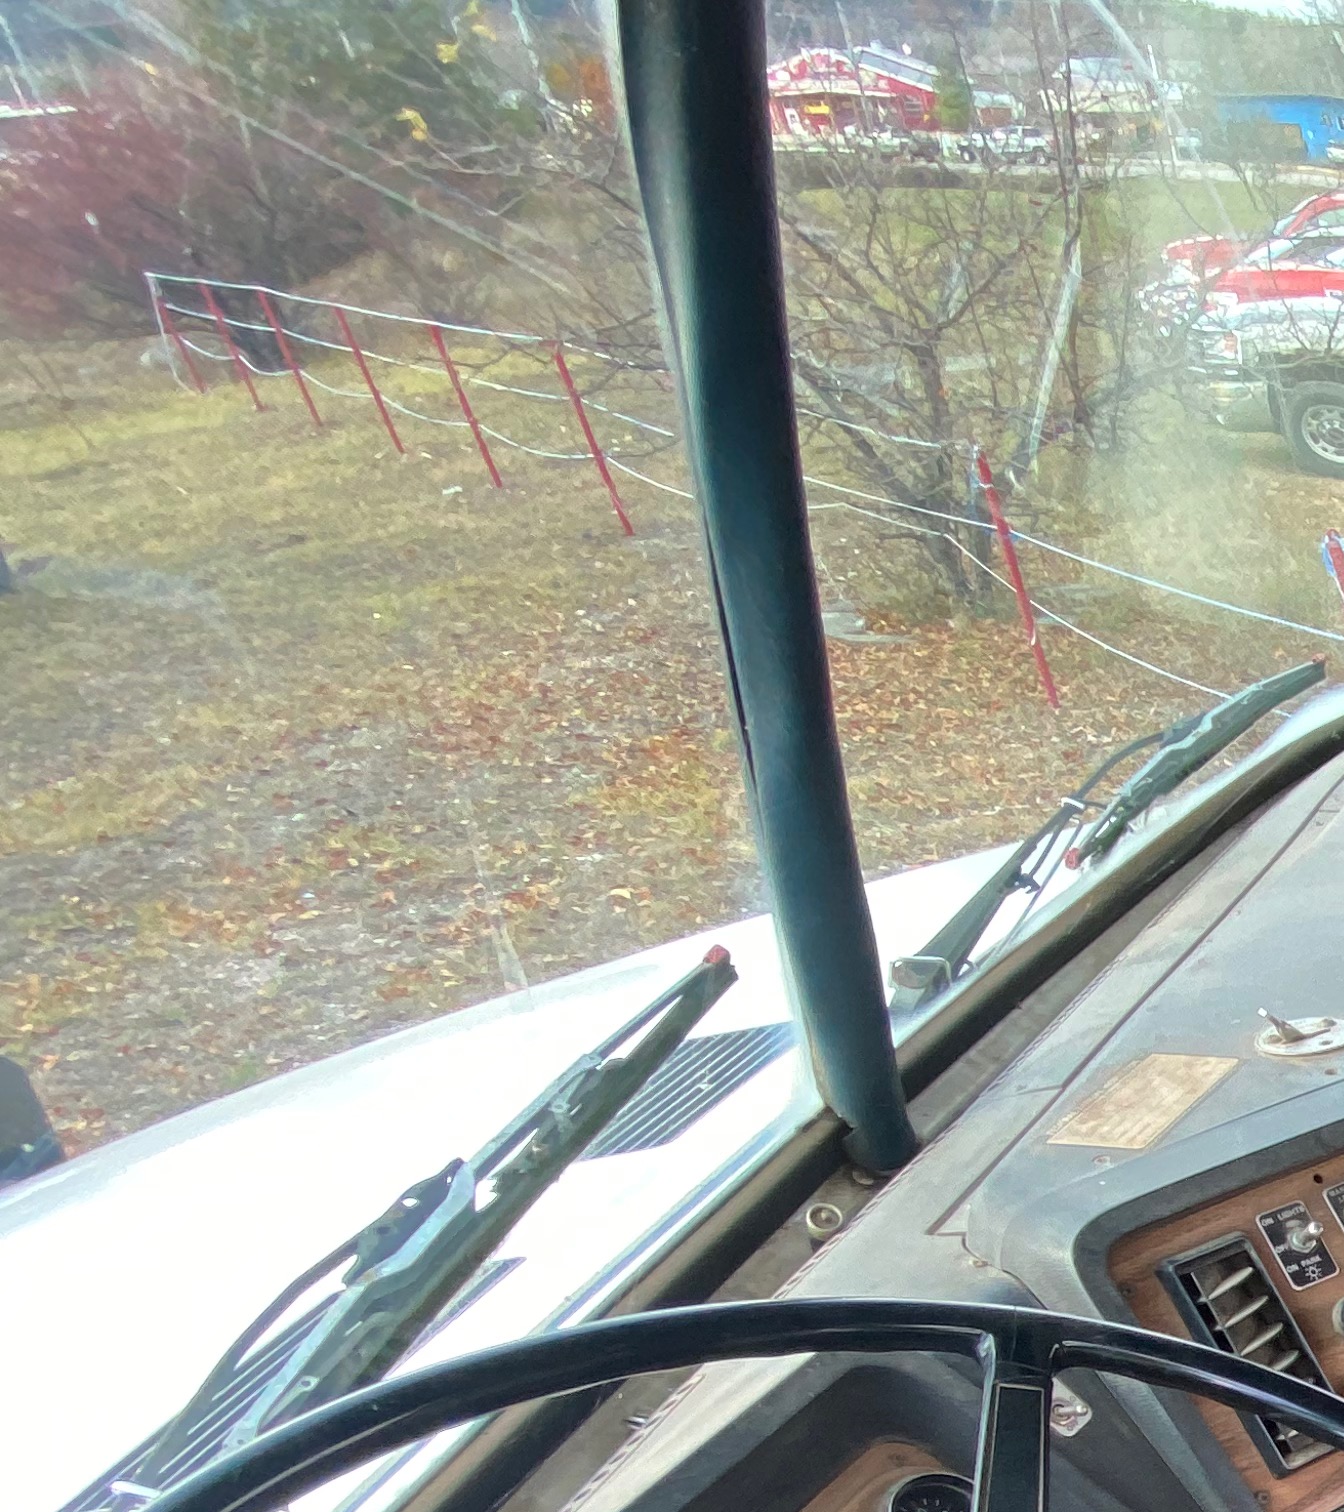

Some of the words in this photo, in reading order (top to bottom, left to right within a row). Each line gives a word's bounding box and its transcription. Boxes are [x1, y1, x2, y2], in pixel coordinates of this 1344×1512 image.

[1261, 1217, 1275, 1227] ON
[1277, 1205, 1306, 1221] LIGHTS
[1286, 1263, 1300, 1274] ON
[1300, 1254, 1323, 1268] PARK
